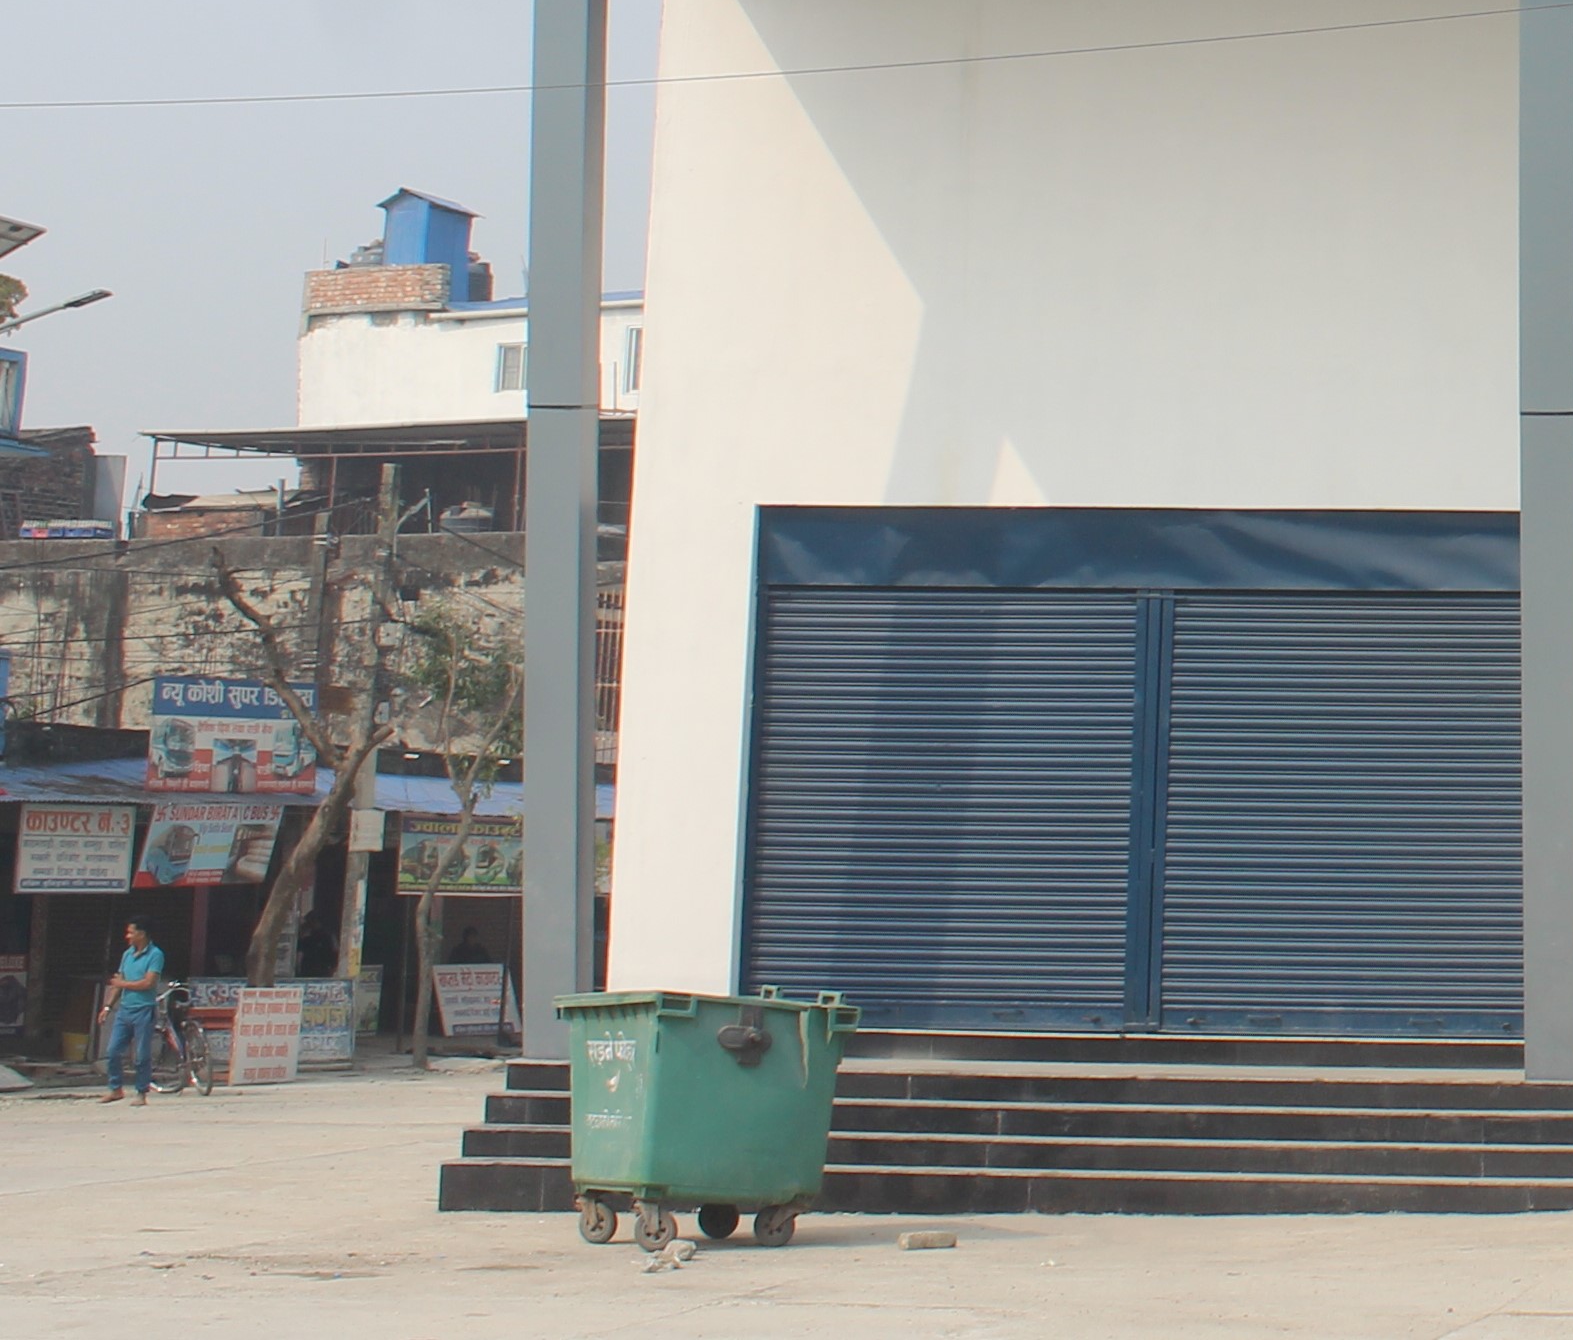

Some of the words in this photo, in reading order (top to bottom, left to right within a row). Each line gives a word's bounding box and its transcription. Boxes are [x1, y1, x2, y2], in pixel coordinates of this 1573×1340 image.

[187, 680, 225, 704] कोशी
[227, 686, 261, 709] सुपर
[26, 810, 94, 834] काउण्टर
